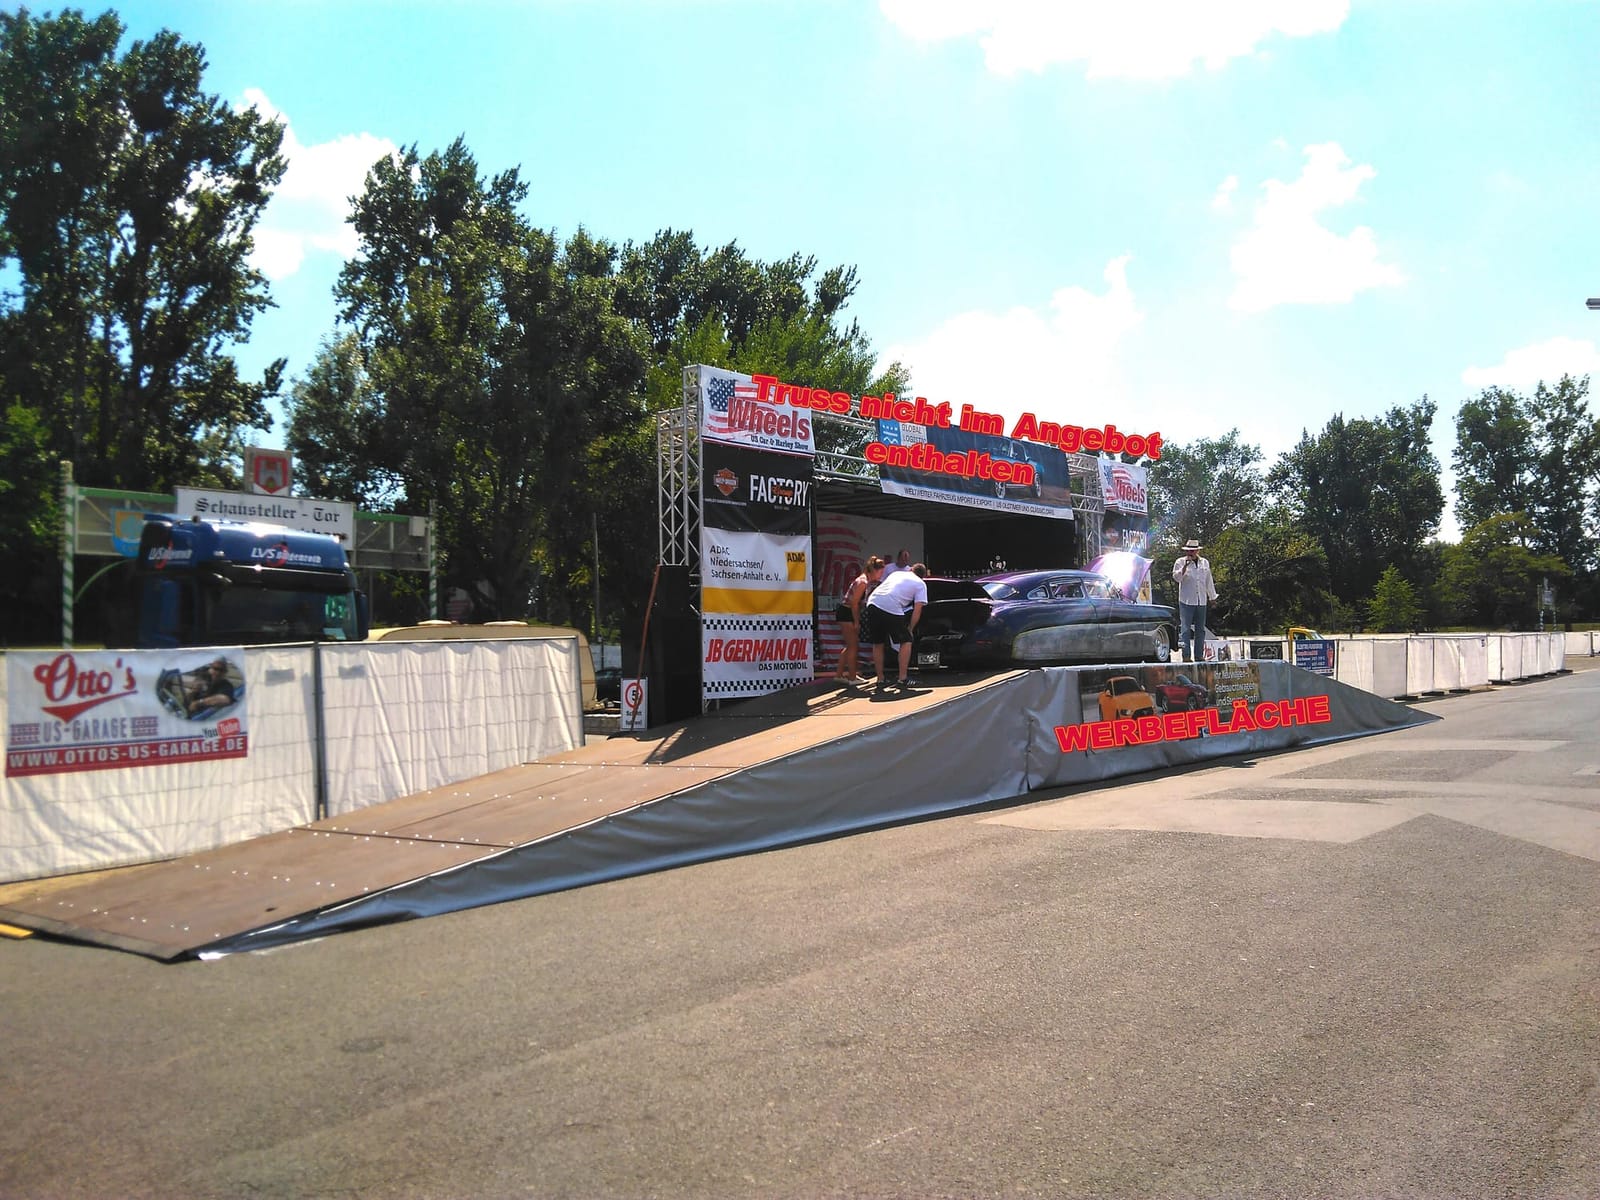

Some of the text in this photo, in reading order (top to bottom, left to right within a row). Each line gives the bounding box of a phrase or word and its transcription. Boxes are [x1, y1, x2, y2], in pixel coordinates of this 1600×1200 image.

[727, 397, 810, 440] Wheels
[749, 474, 810, 507] FACTORY
[195, 498, 296, 519] Schausteller
[313, 507, 340, 523] Tor
[251, 547, 276, 559] LVS
[710, 544, 730, 555] ADAC
[786, 552, 806, 563] ADAC
[710, 557, 764, 570] Niedersachsen/
[711, 568, 763, 581] Sachsen-Anhalt
[723, 638, 788, 662] GERMAN
[788, 638, 808, 661] OIL
[34, 652, 136, 701] Otto's
[758, 663, 772, 671] DAS
[43, 716, 127, 743] US-GARAGE
[9, 736, 244, 769] WWW.OTTOS-US-GARAGE.DE
